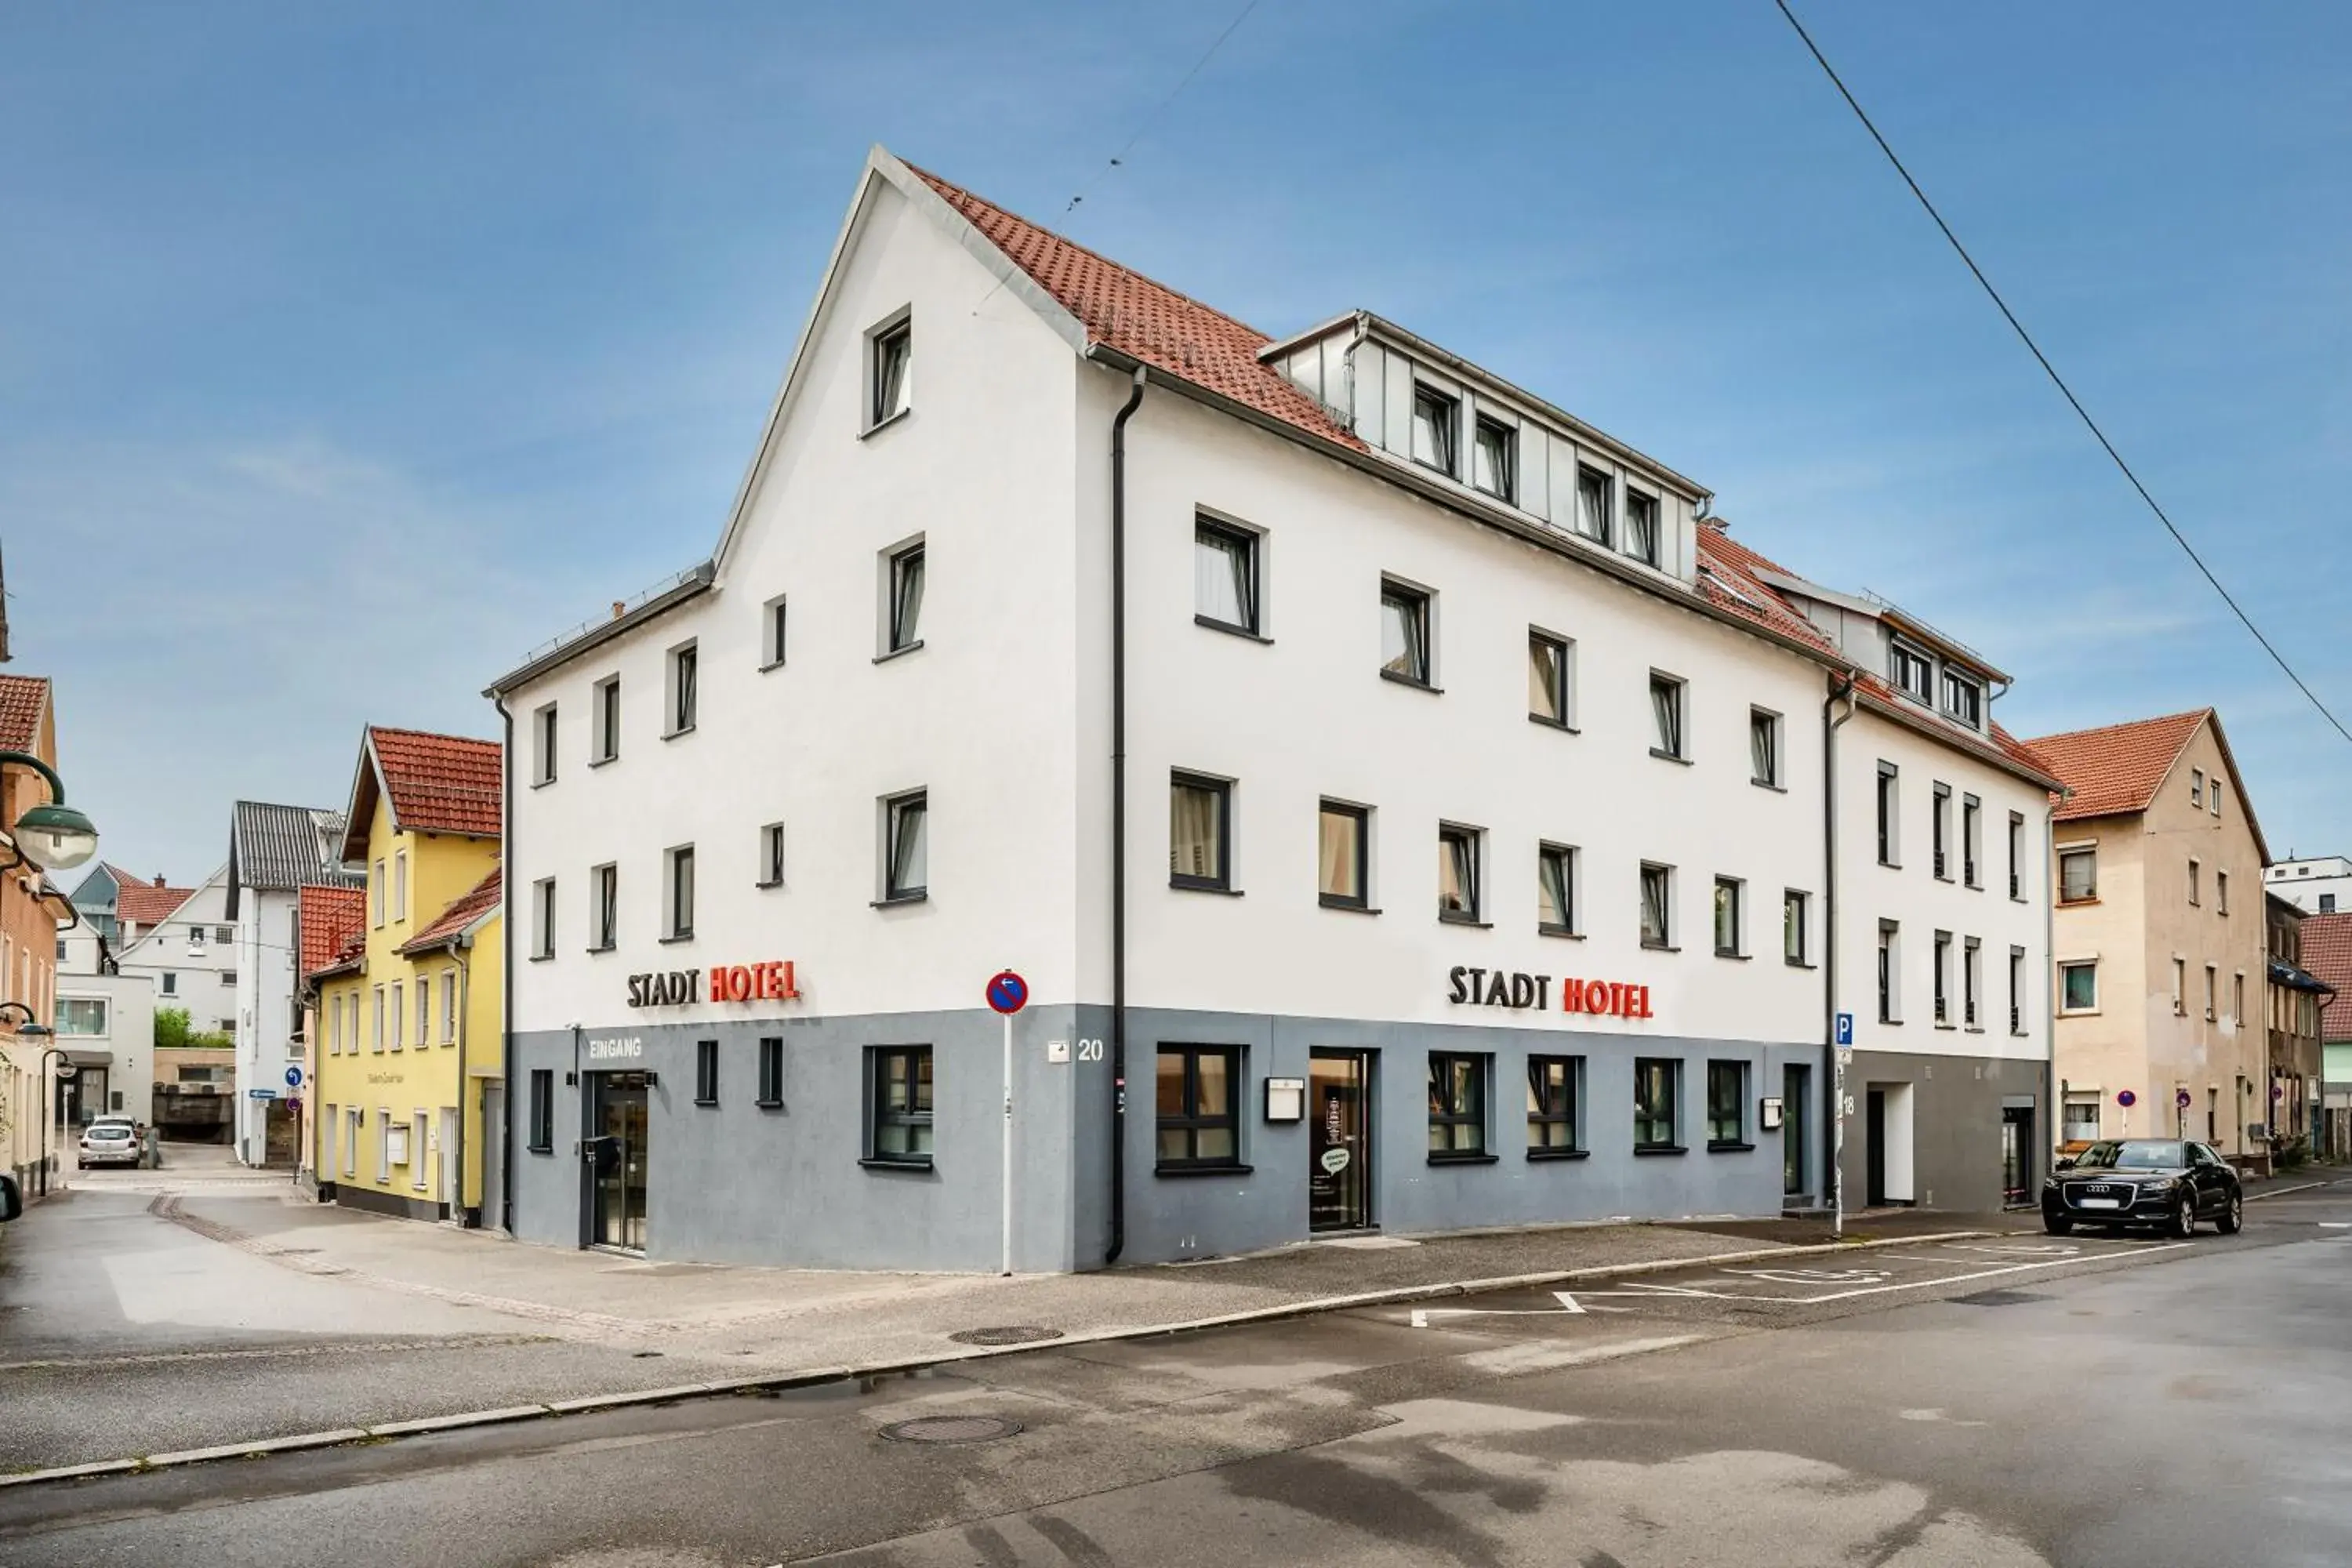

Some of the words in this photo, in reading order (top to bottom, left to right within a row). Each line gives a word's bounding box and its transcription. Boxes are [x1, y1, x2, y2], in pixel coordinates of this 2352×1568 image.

[627, 968, 700, 1007] STADT
[710, 960, 800, 1003] HOTEL
[1449, 965, 1552, 1010] STADT
[1563, 978, 1653, 1018] HOTEL
[1838, 1017, 1849, 1042] P
[590, 1037, 641, 1059] EINGANG
[1078, 1038, 1103, 1061] 20
[1844, 1095, 1854, 1115] 18
